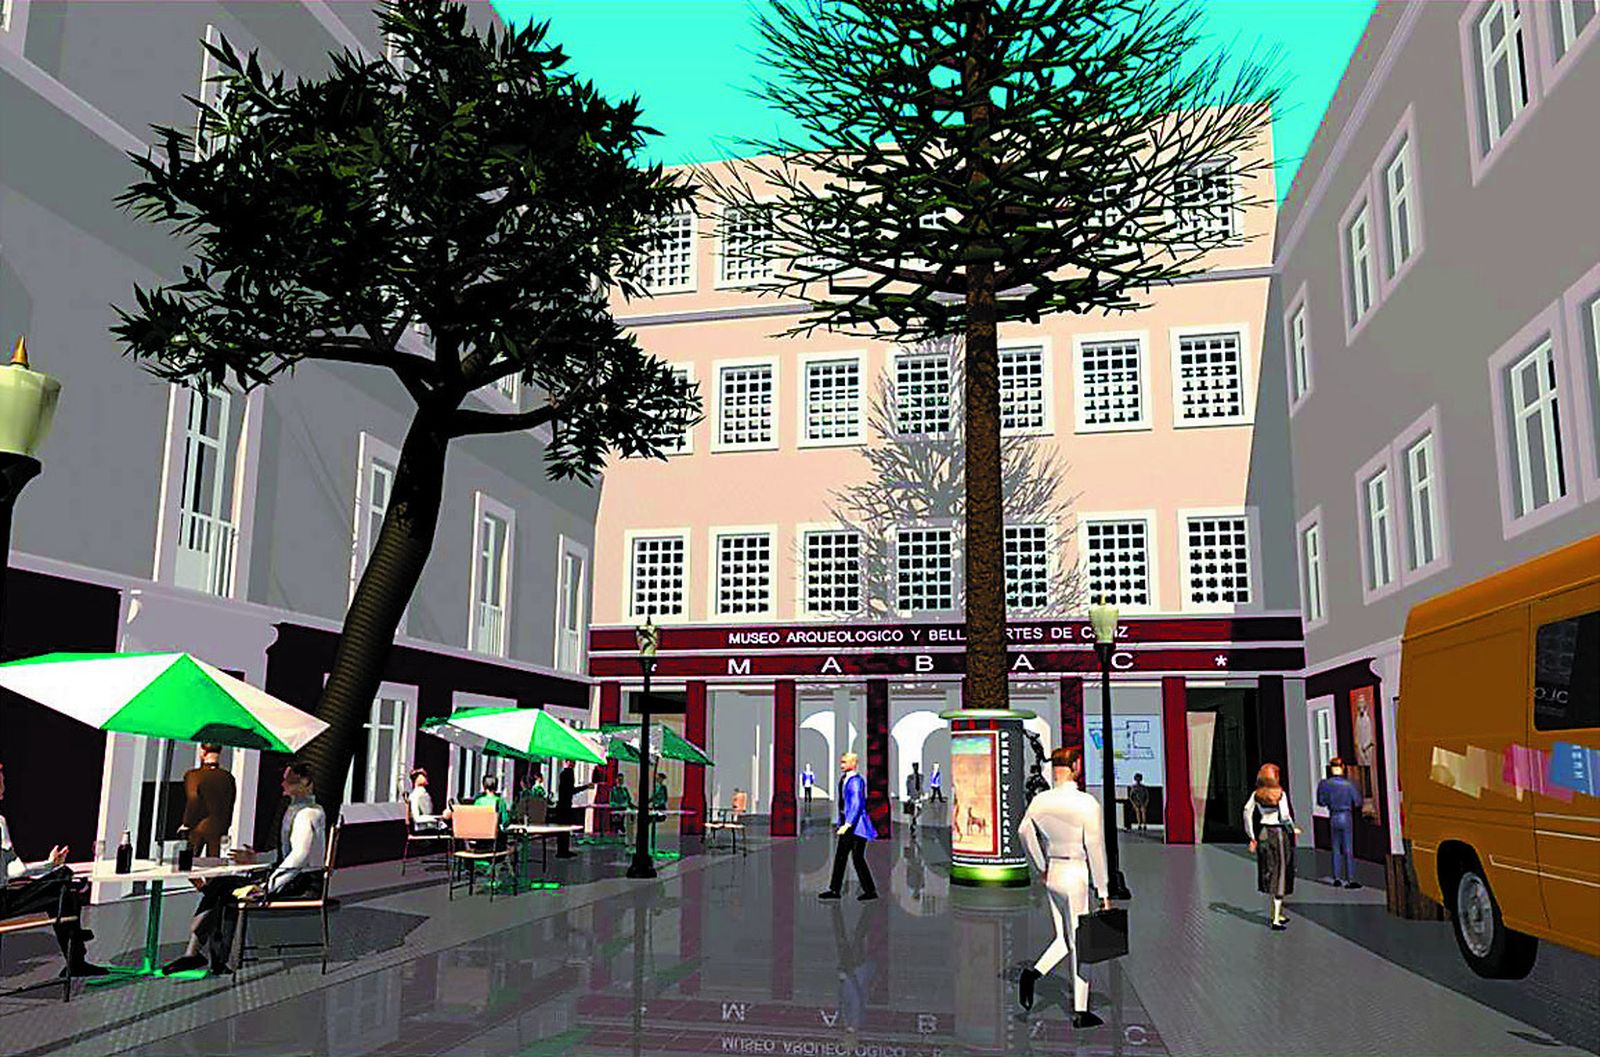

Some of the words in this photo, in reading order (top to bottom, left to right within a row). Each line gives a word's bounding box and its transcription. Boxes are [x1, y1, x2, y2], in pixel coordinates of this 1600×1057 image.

[728, 632, 780, 644] MUSEO
[786, 629, 904, 643] ARQUEOLOGICO
[910, 629, 921, 641] Y
[928, 628, 967, 641] BELL
[1005, 626, 1043, 640] RTES
[1051, 627, 1072, 639] DE
[1081, 626, 1128, 639] CIZ
